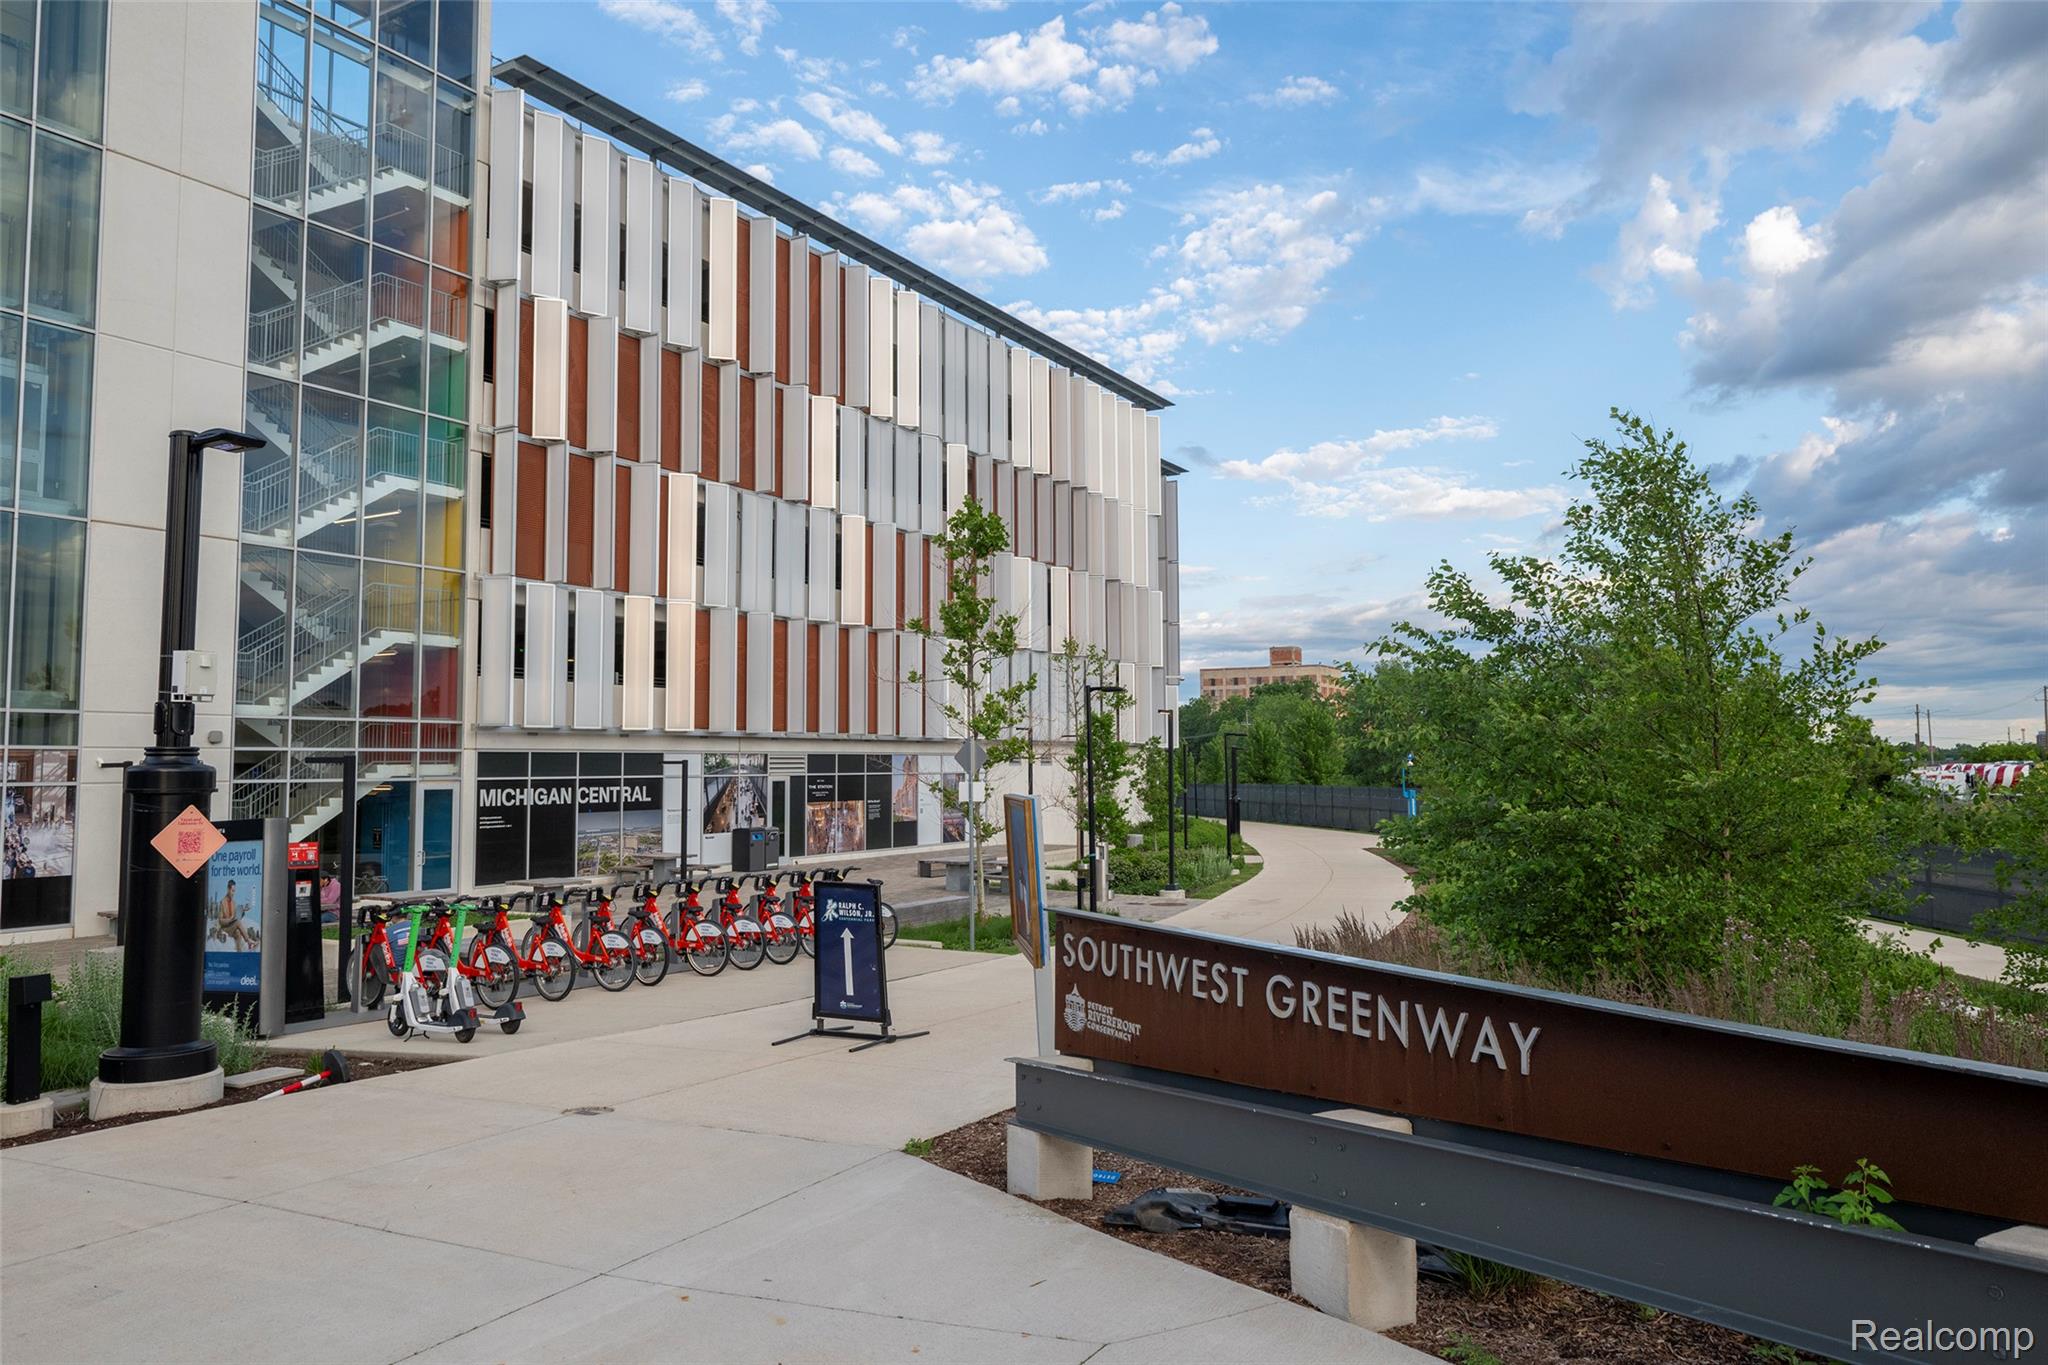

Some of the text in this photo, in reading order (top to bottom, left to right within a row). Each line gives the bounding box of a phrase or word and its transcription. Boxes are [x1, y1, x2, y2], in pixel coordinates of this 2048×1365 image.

[480, 785, 652, 807] MICHIGAN CENTRAL
[211, 848, 256, 864] One payroll
[211, 863, 262, 877] for the world.
[838, 902, 865, 911] RALPH C.
[838, 909, 875, 919] WILSON, JR.
[1062, 932, 1541, 1076] SOUTHWEST GREENWAY
[1087, 1001, 1114, 1015] DETROIT
[1087, 1010, 1141, 1035] RIVERFRONT
[1087, 1021, 1132, 1042] CONSERVANCY
